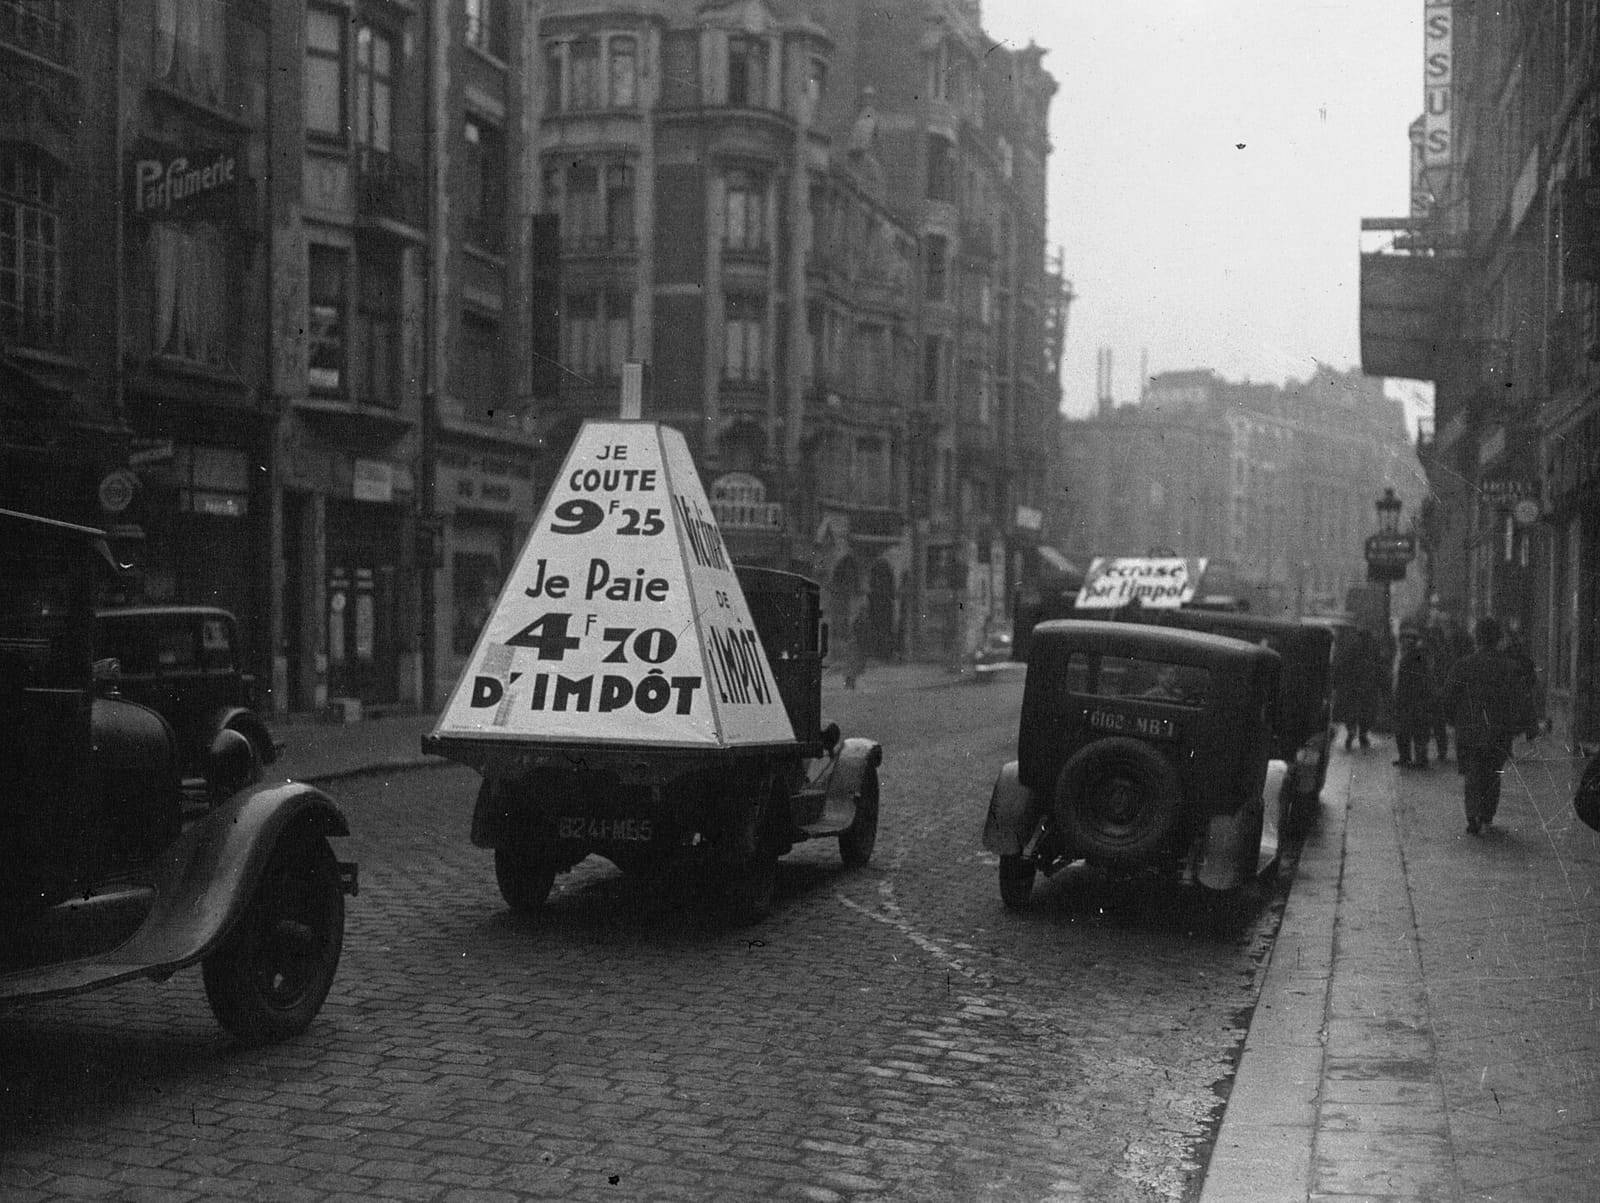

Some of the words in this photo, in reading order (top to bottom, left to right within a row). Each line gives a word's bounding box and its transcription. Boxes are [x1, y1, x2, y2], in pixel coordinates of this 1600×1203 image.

[1426, 0, 1450, 153] SSUS
[136, 153, 236, 212] Parfumerie
[596, 446, 628, 460] JE
[570, 469, 657, 491] COUTE
[525, 558, 570, 599] Je
[585, 558, 670, 602] Paie
[715, 589, 731, 609] DE
[471, 668, 702, 715] D'IMPÔT
